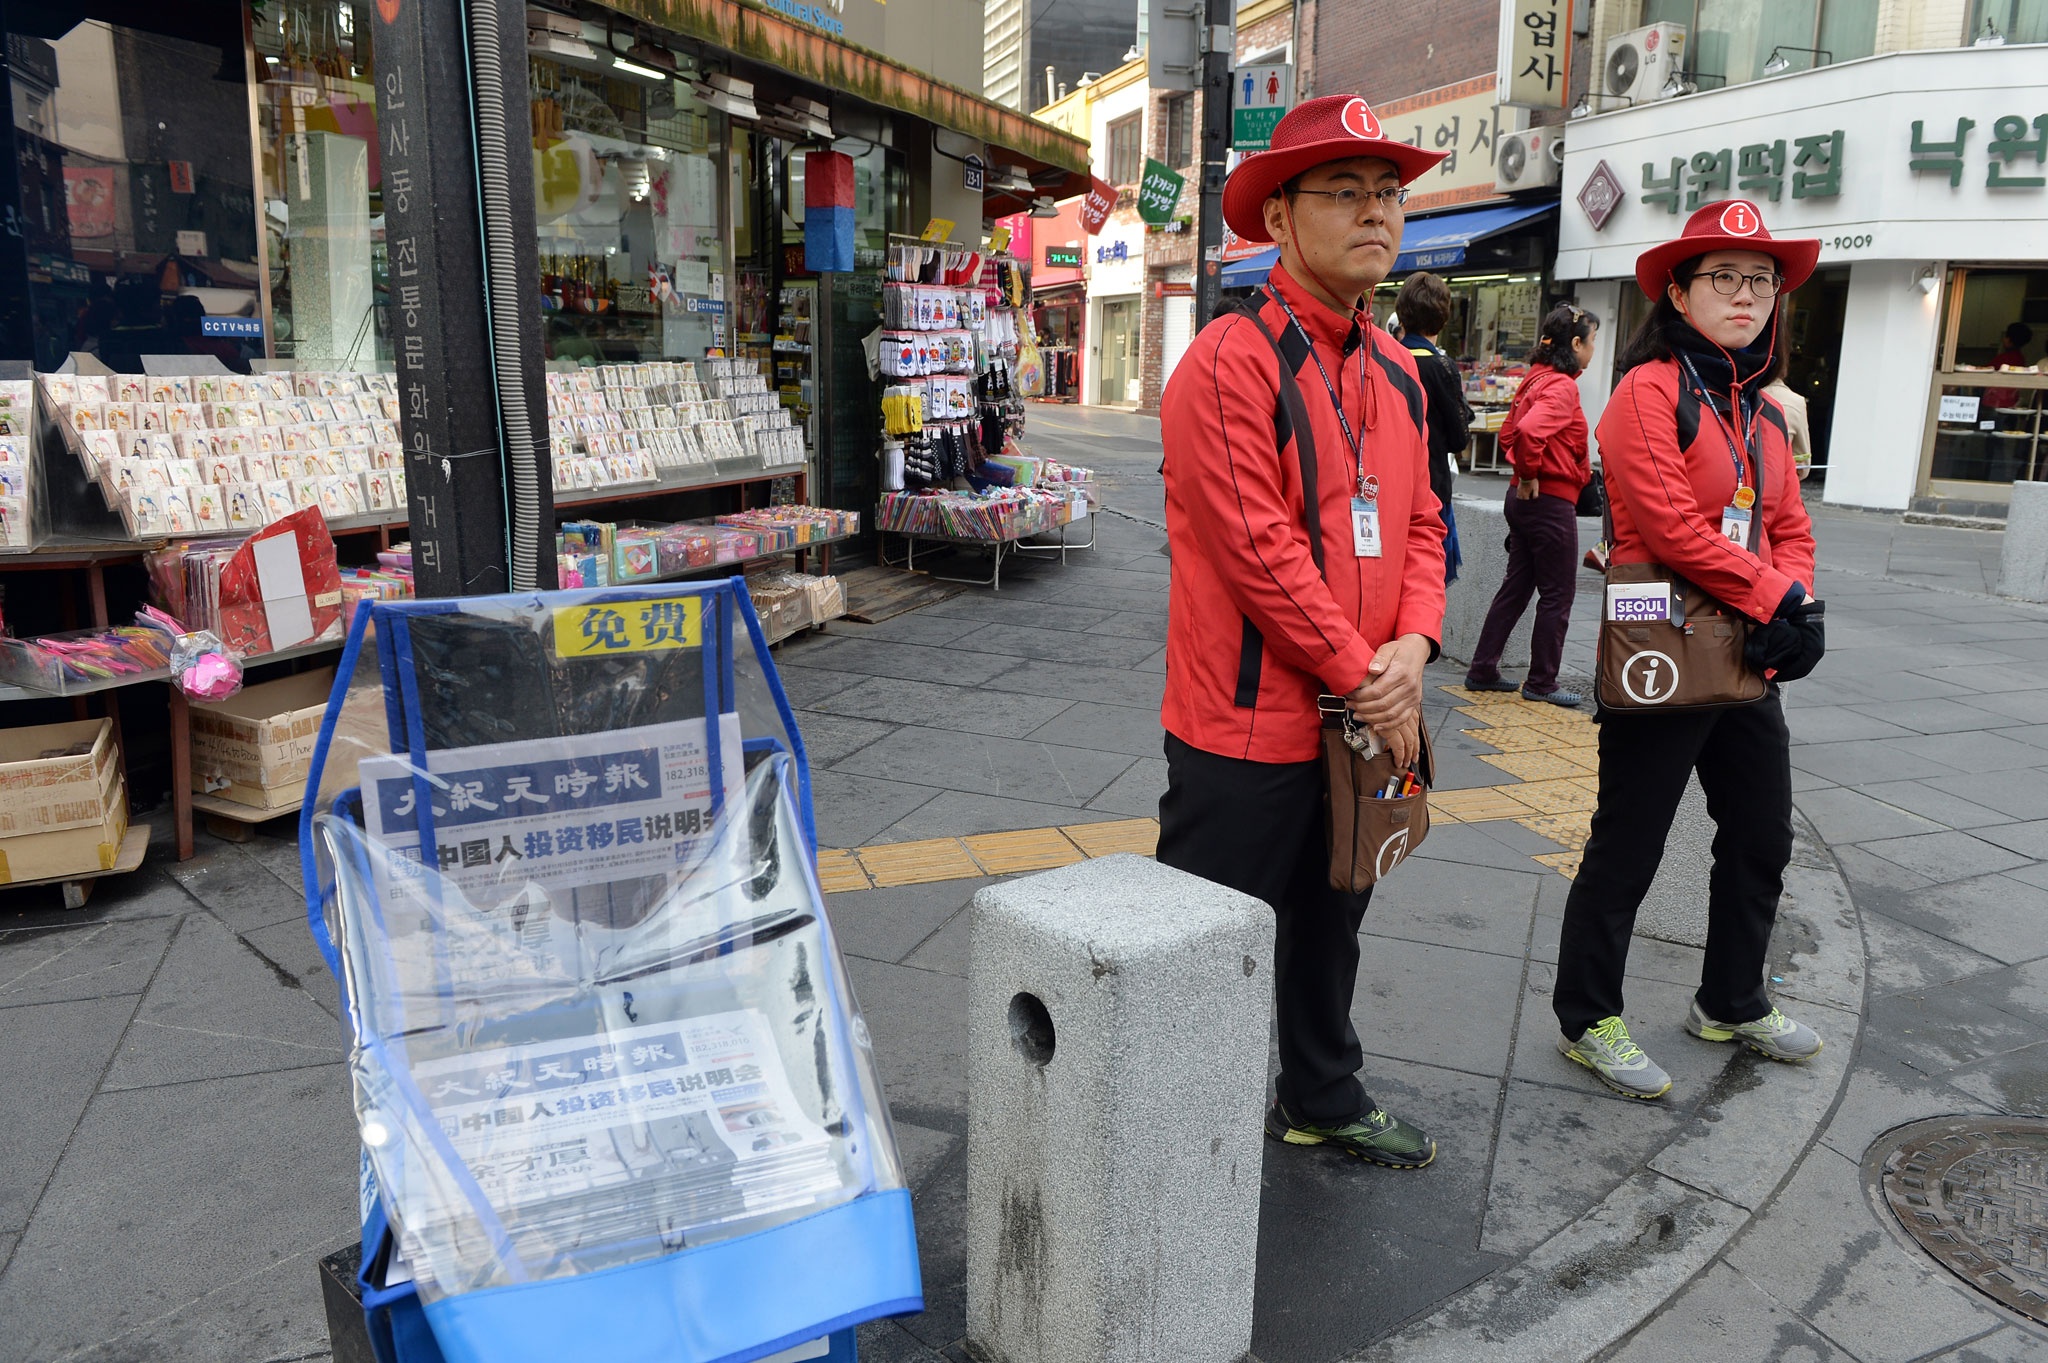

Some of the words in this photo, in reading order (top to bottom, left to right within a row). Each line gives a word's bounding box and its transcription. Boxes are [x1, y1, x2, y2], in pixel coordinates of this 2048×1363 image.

[813, 6, 844, 36] Store
[1519, 0, 1563, 91] 업사
[1644, 54, 1657, 66] LG
[386, 66, 413, 214] 인사동
[1247, 121, 1273, 129] TOILET
[1641, 129, 1846, 215] 낙원떡집
[1416, 254, 1433, 267] VISA
[204, 321, 260, 333] CCTV녹화중
[396, 236, 433, 466] 전통문화의
[416, 495, 442, 574] 거리
[1616, 600, 1664, 613] SEOUL
[578, 602, 687, 652] 免费
[290, 740, 313, 759] Phone
